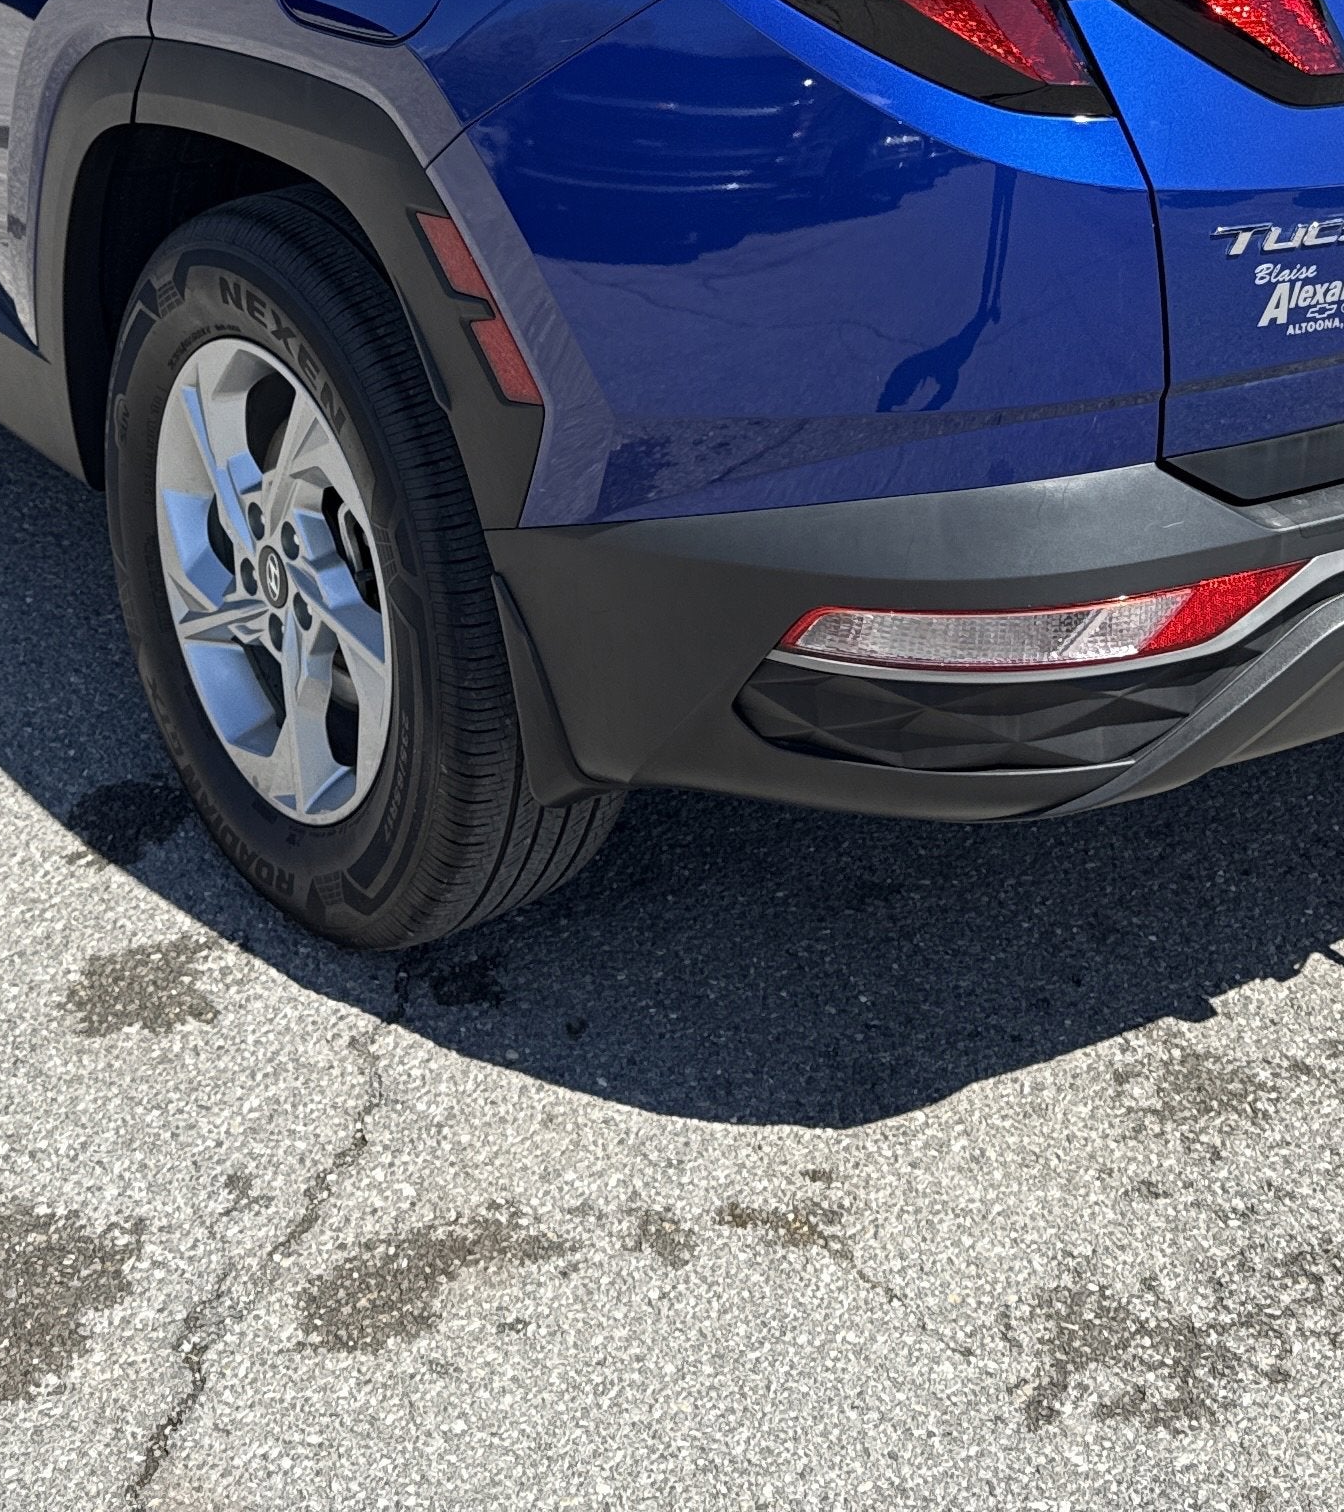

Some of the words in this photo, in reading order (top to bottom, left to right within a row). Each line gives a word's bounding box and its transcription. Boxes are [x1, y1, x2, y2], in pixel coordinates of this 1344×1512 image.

[1254, 263, 1317, 285] Blaise
[1286, 320, 1344, 336] ALTOONA,
[219, 276, 347, 436] NEXEN
